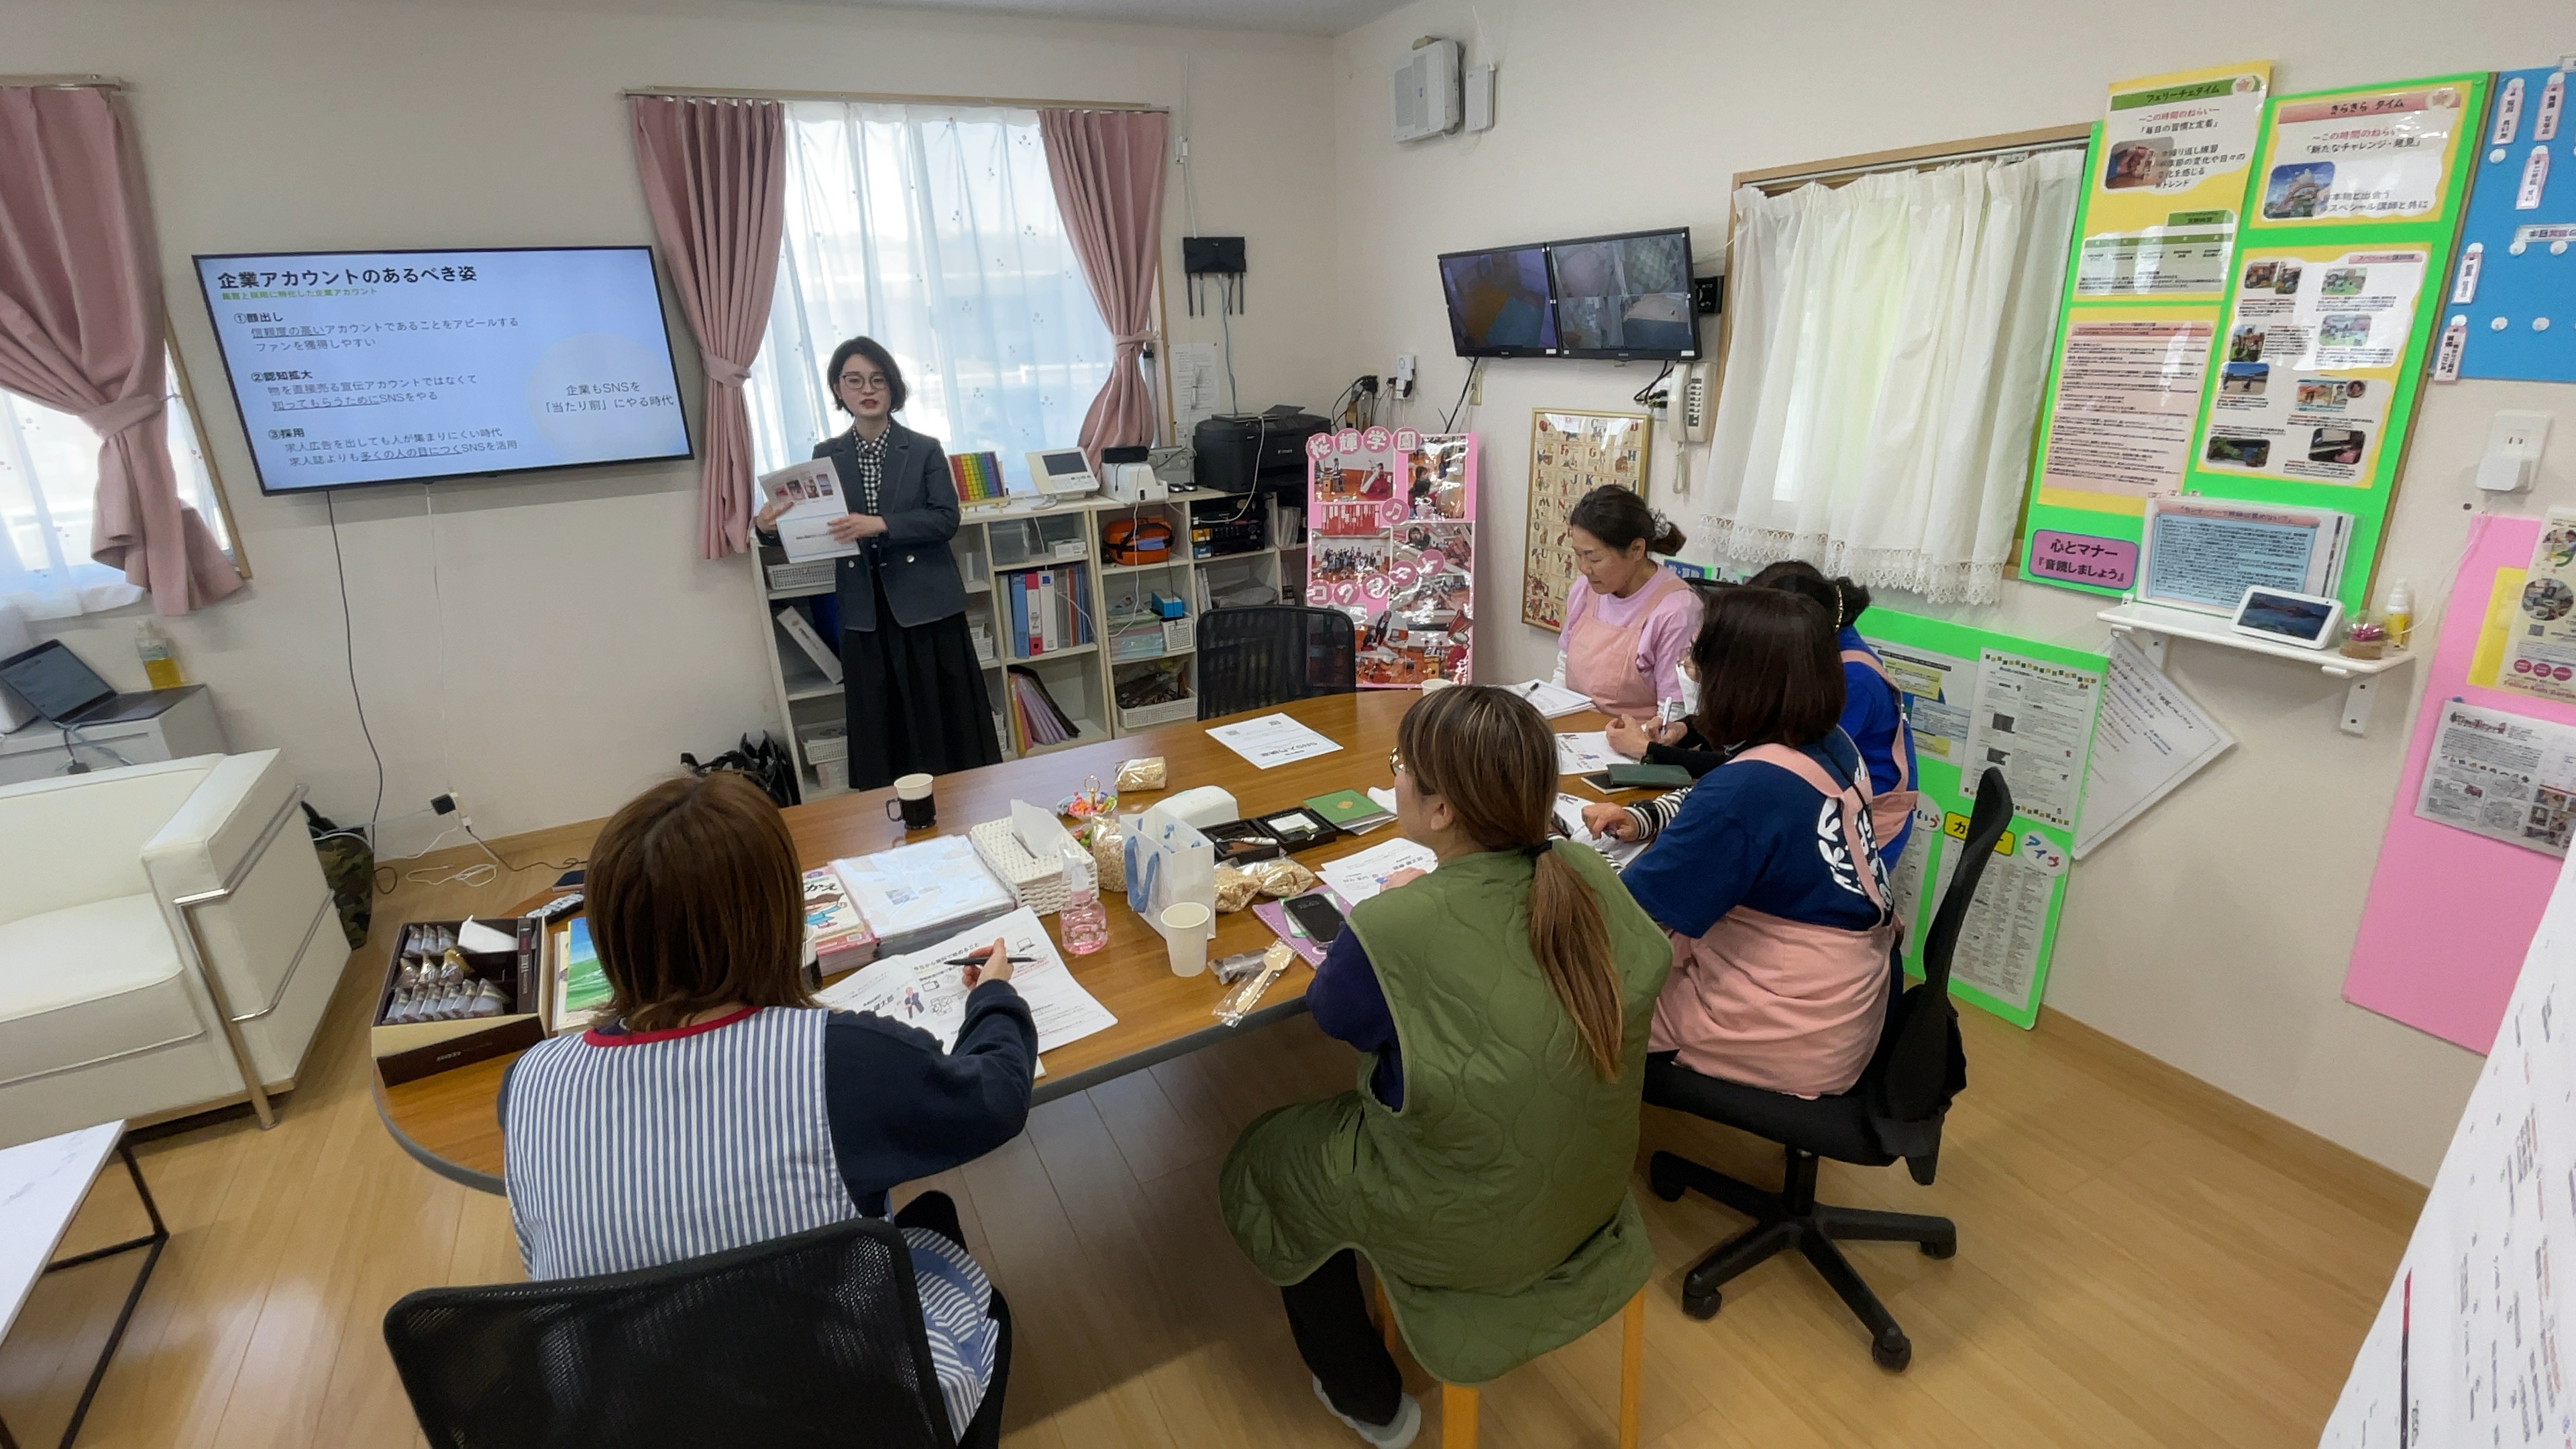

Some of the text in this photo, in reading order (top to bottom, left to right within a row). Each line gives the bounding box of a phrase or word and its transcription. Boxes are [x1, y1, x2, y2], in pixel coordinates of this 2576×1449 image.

[217, 265, 478, 289] 企業アカウントのあるべき姿
[251, 317, 519, 338] 信頼度の高いアカウントであることをアピールする
[256, 338, 376, 353] ファンを獲得しやすい
[251, 369, 313, 382] ②認知拡大
[566, 382, 640, 396] 企業もSNSを
[272, 391, 438, 411] 知ってもらうためにSNSをやる
[545, 394, 674, 413] 「当たり前」にやる時代
[268, 427, 305, 440] ③採用
[284, 427, 503, 453] 求人広告を出しても人が集まりにくい時代
[289, 439, 518, 467] 求人誌よりも多くの人の目につくSNSを活用
[2050, 537, 2118, 558] 心とマナー
[2038, 556, 2125, 582] 『音読しましょう』
